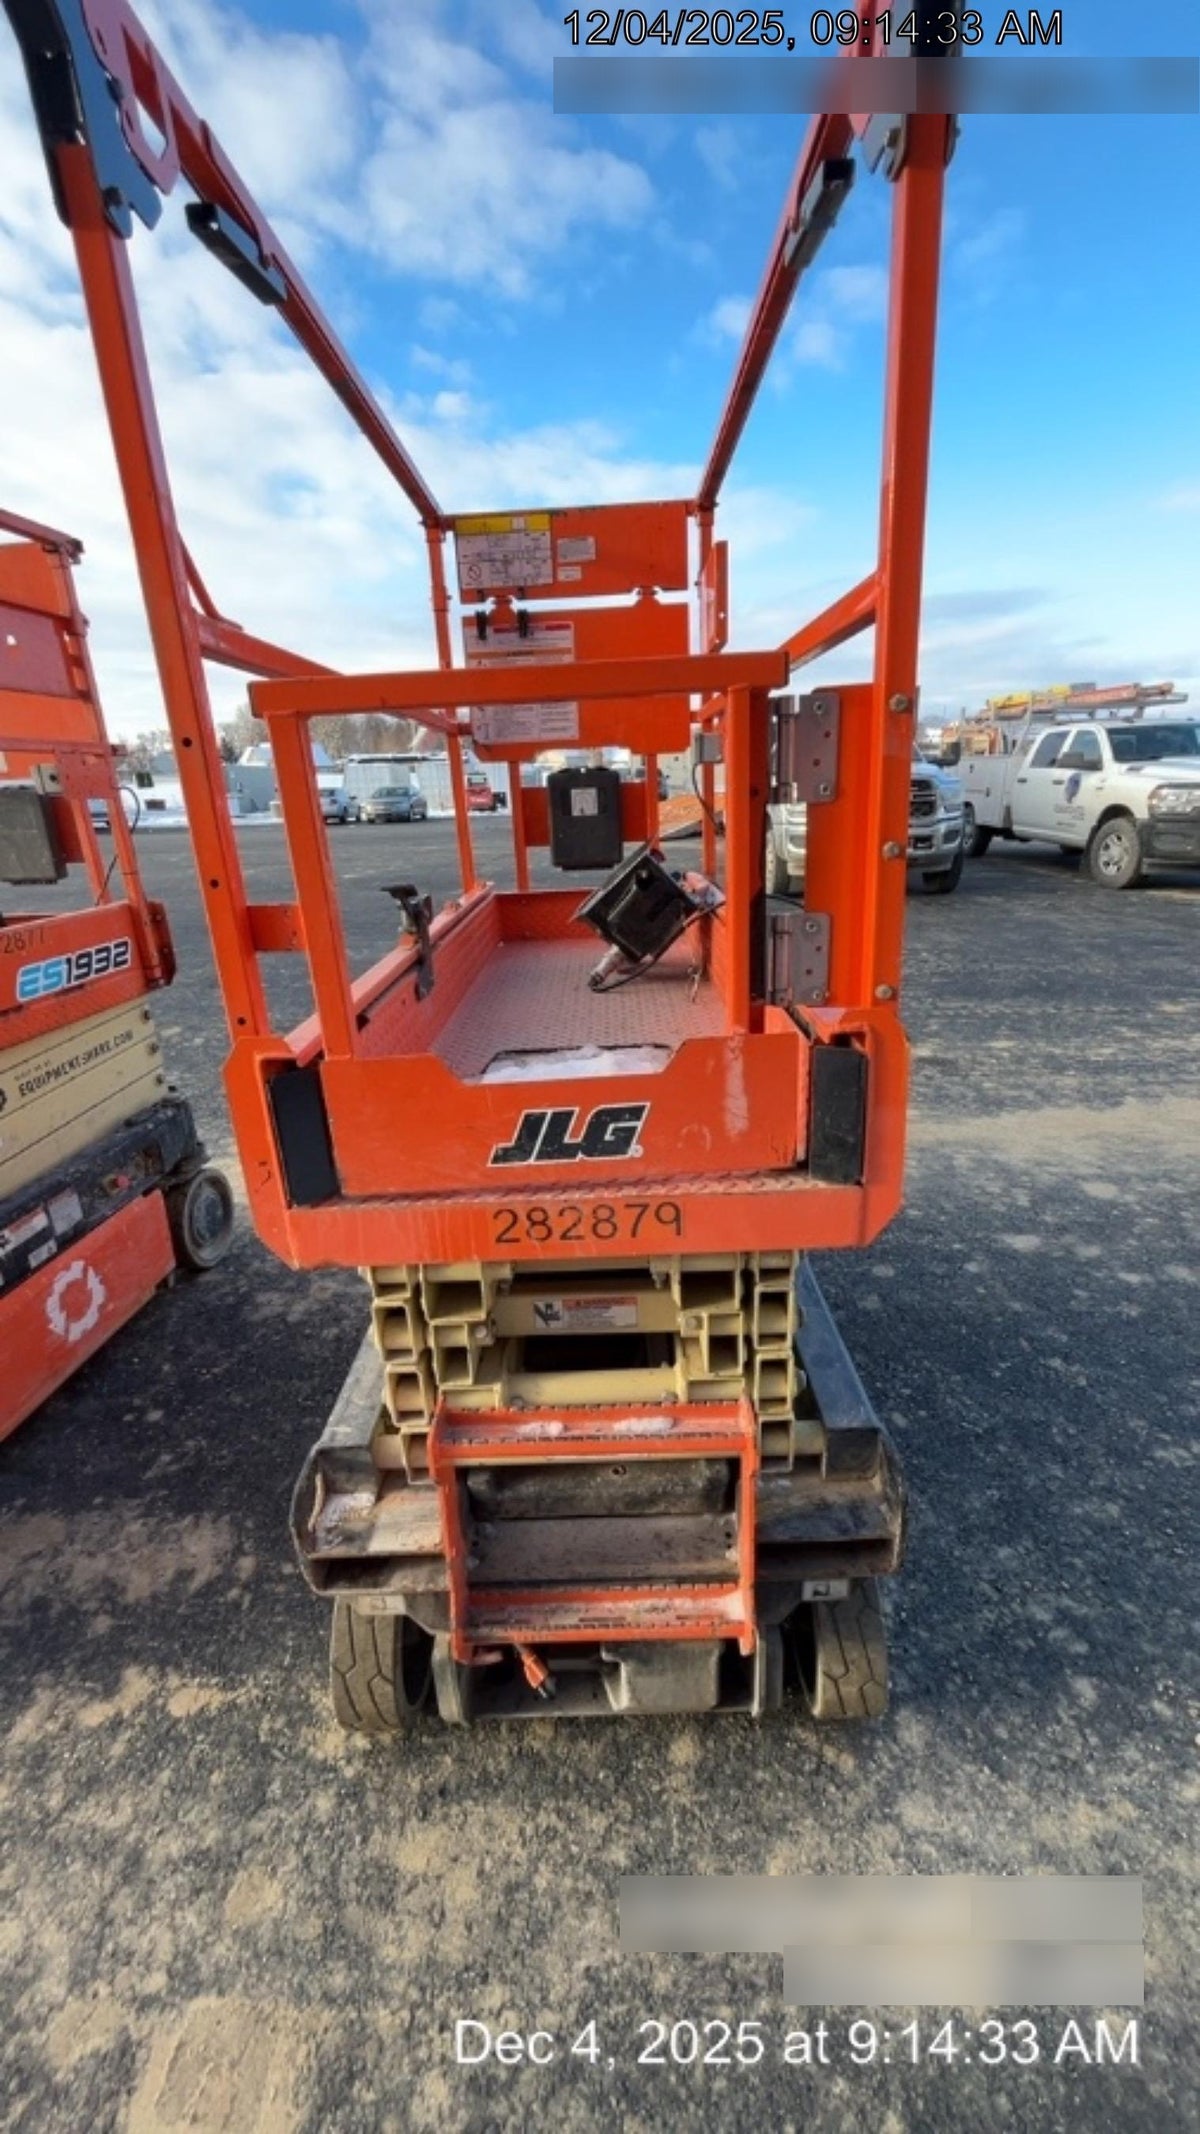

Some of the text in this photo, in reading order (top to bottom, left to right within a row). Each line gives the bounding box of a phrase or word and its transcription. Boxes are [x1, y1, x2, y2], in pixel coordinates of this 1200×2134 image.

[17, 938, 131, 1001] ES1932
[487, 1101, 651, 1167] JLG
[493, 1201, 683, 1244] 282879
